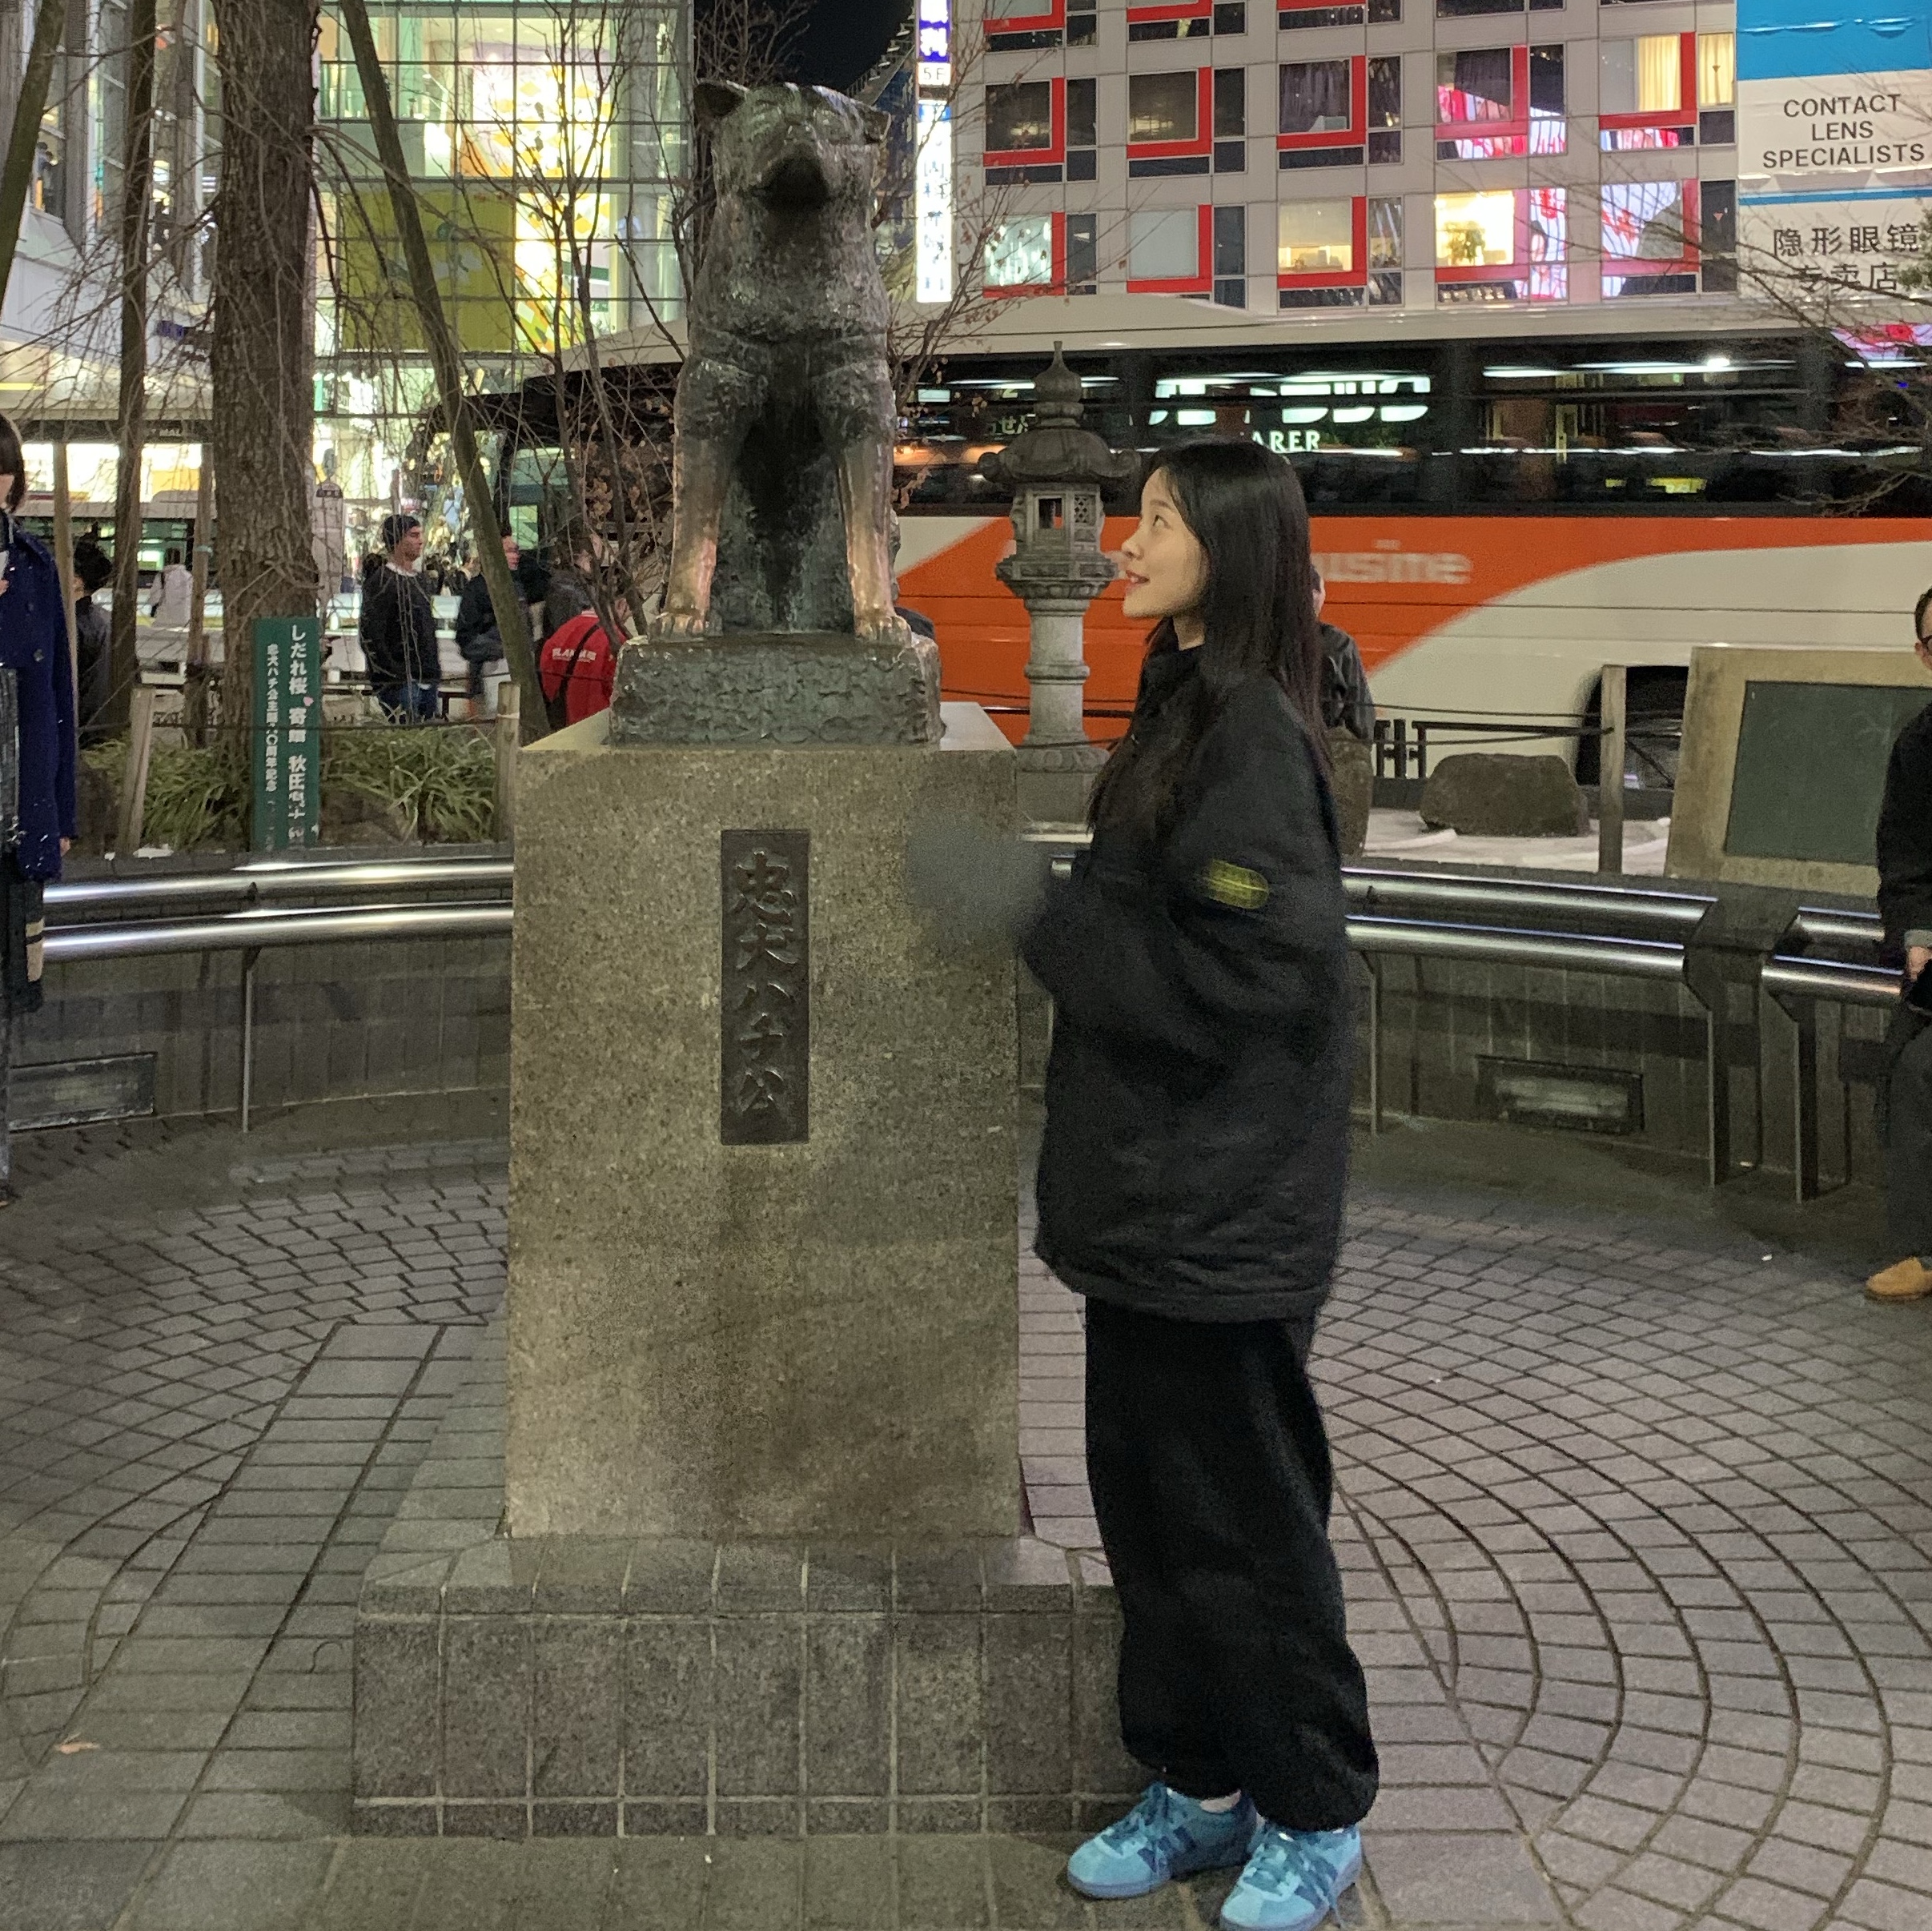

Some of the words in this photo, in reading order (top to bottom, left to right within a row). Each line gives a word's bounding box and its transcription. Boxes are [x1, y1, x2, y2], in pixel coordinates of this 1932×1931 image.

[1783, 93, 1901, 118] CONTACT
[1811, 120, 1874, 141] LENS
[1762, 143, 1925, 169] SPECIALISTS
[1773, 223, 1920, 257] 隐形眼镜
[289, 624, 307, 695] しだれ桜
[732, 850, 797, 1114] 忠犬ハチ公
